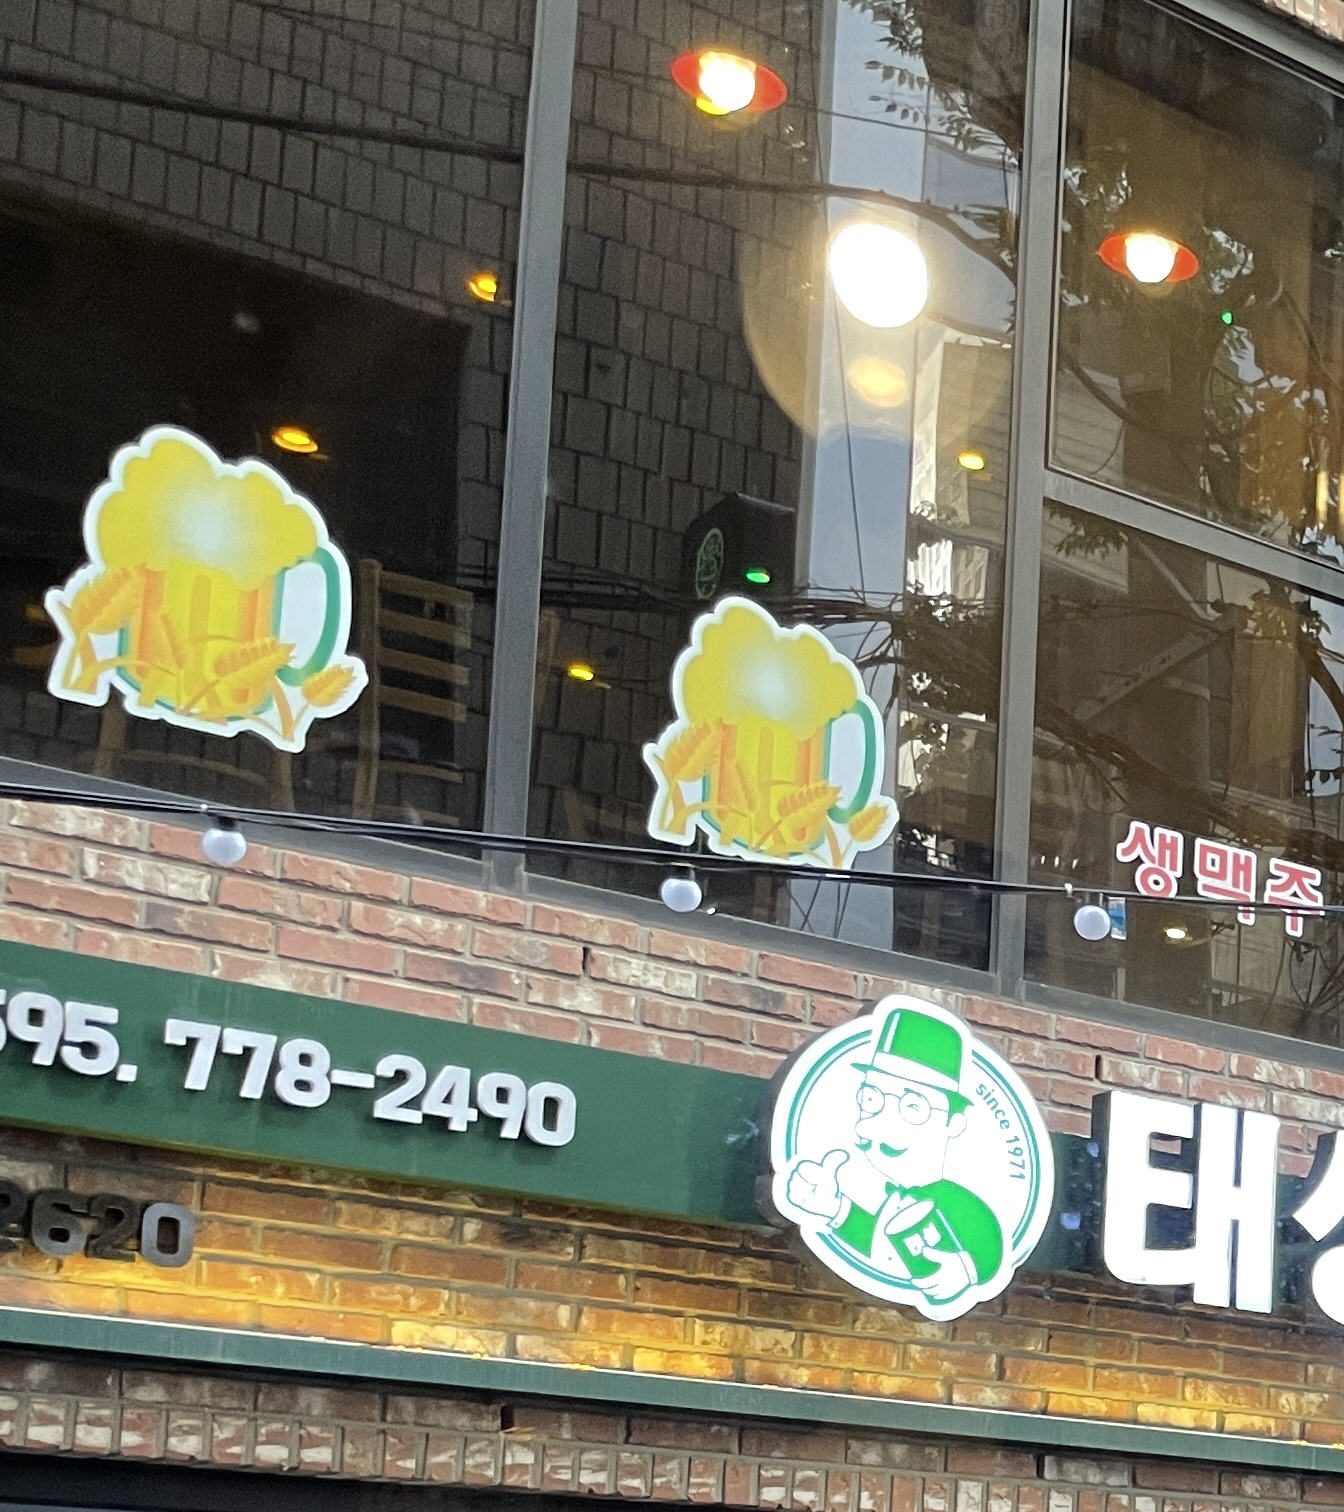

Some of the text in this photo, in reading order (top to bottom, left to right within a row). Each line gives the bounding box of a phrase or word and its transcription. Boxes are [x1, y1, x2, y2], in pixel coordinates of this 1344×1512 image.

[1116, 821, 1324, 937] 생맥주
[164, 1018, 577, 1147] 778-2490
[975, 1083, 1026, 1180] since 1971
